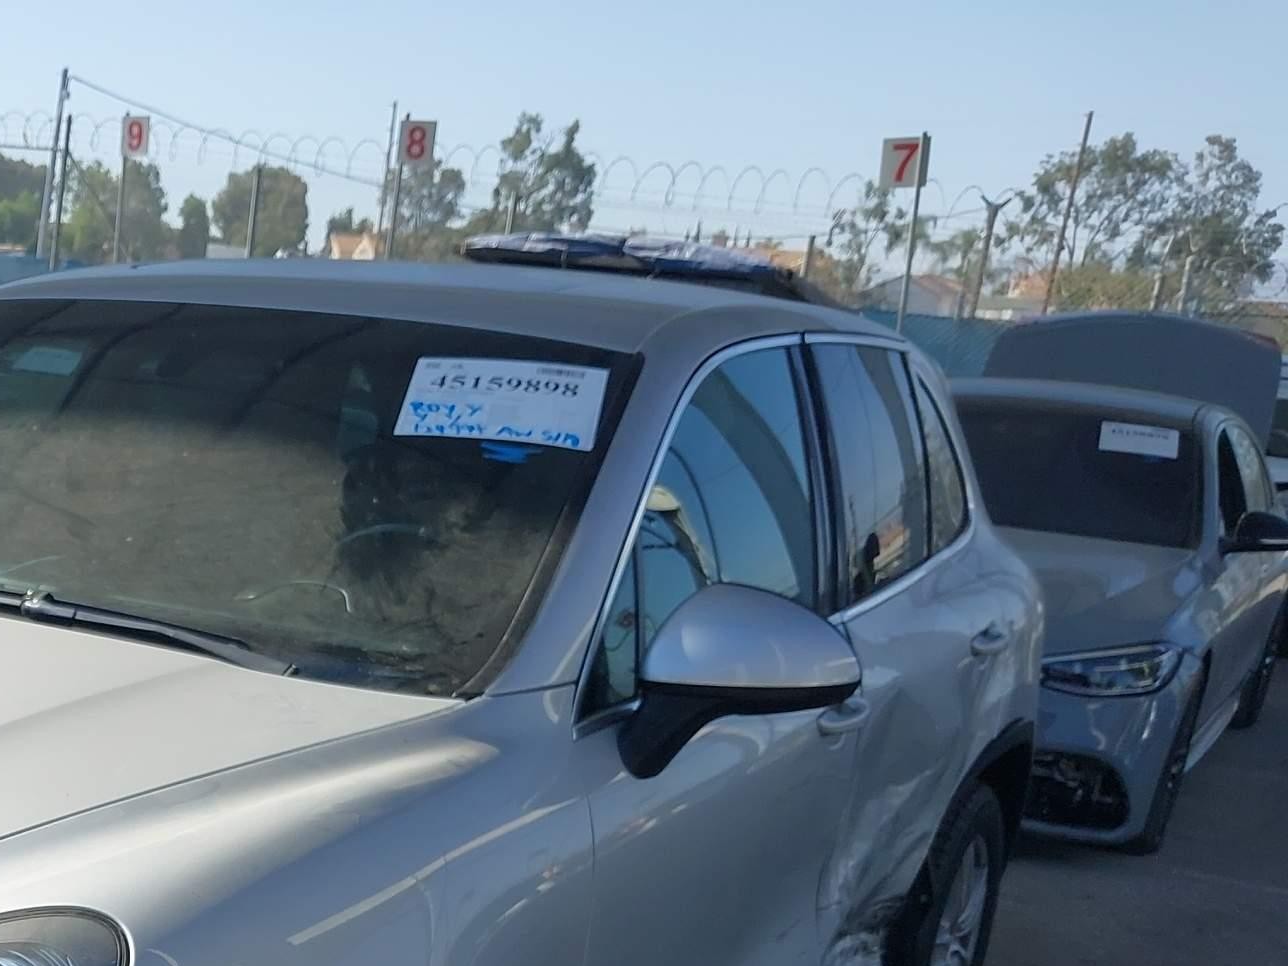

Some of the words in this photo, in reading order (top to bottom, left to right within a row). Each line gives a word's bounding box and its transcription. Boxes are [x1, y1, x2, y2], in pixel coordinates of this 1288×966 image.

[128, 120, 143, 151] 9
[406, 125, 426, 160] 8
[892, 142, 919, 182] 7
[429, 374, 580, 398] 45159898
